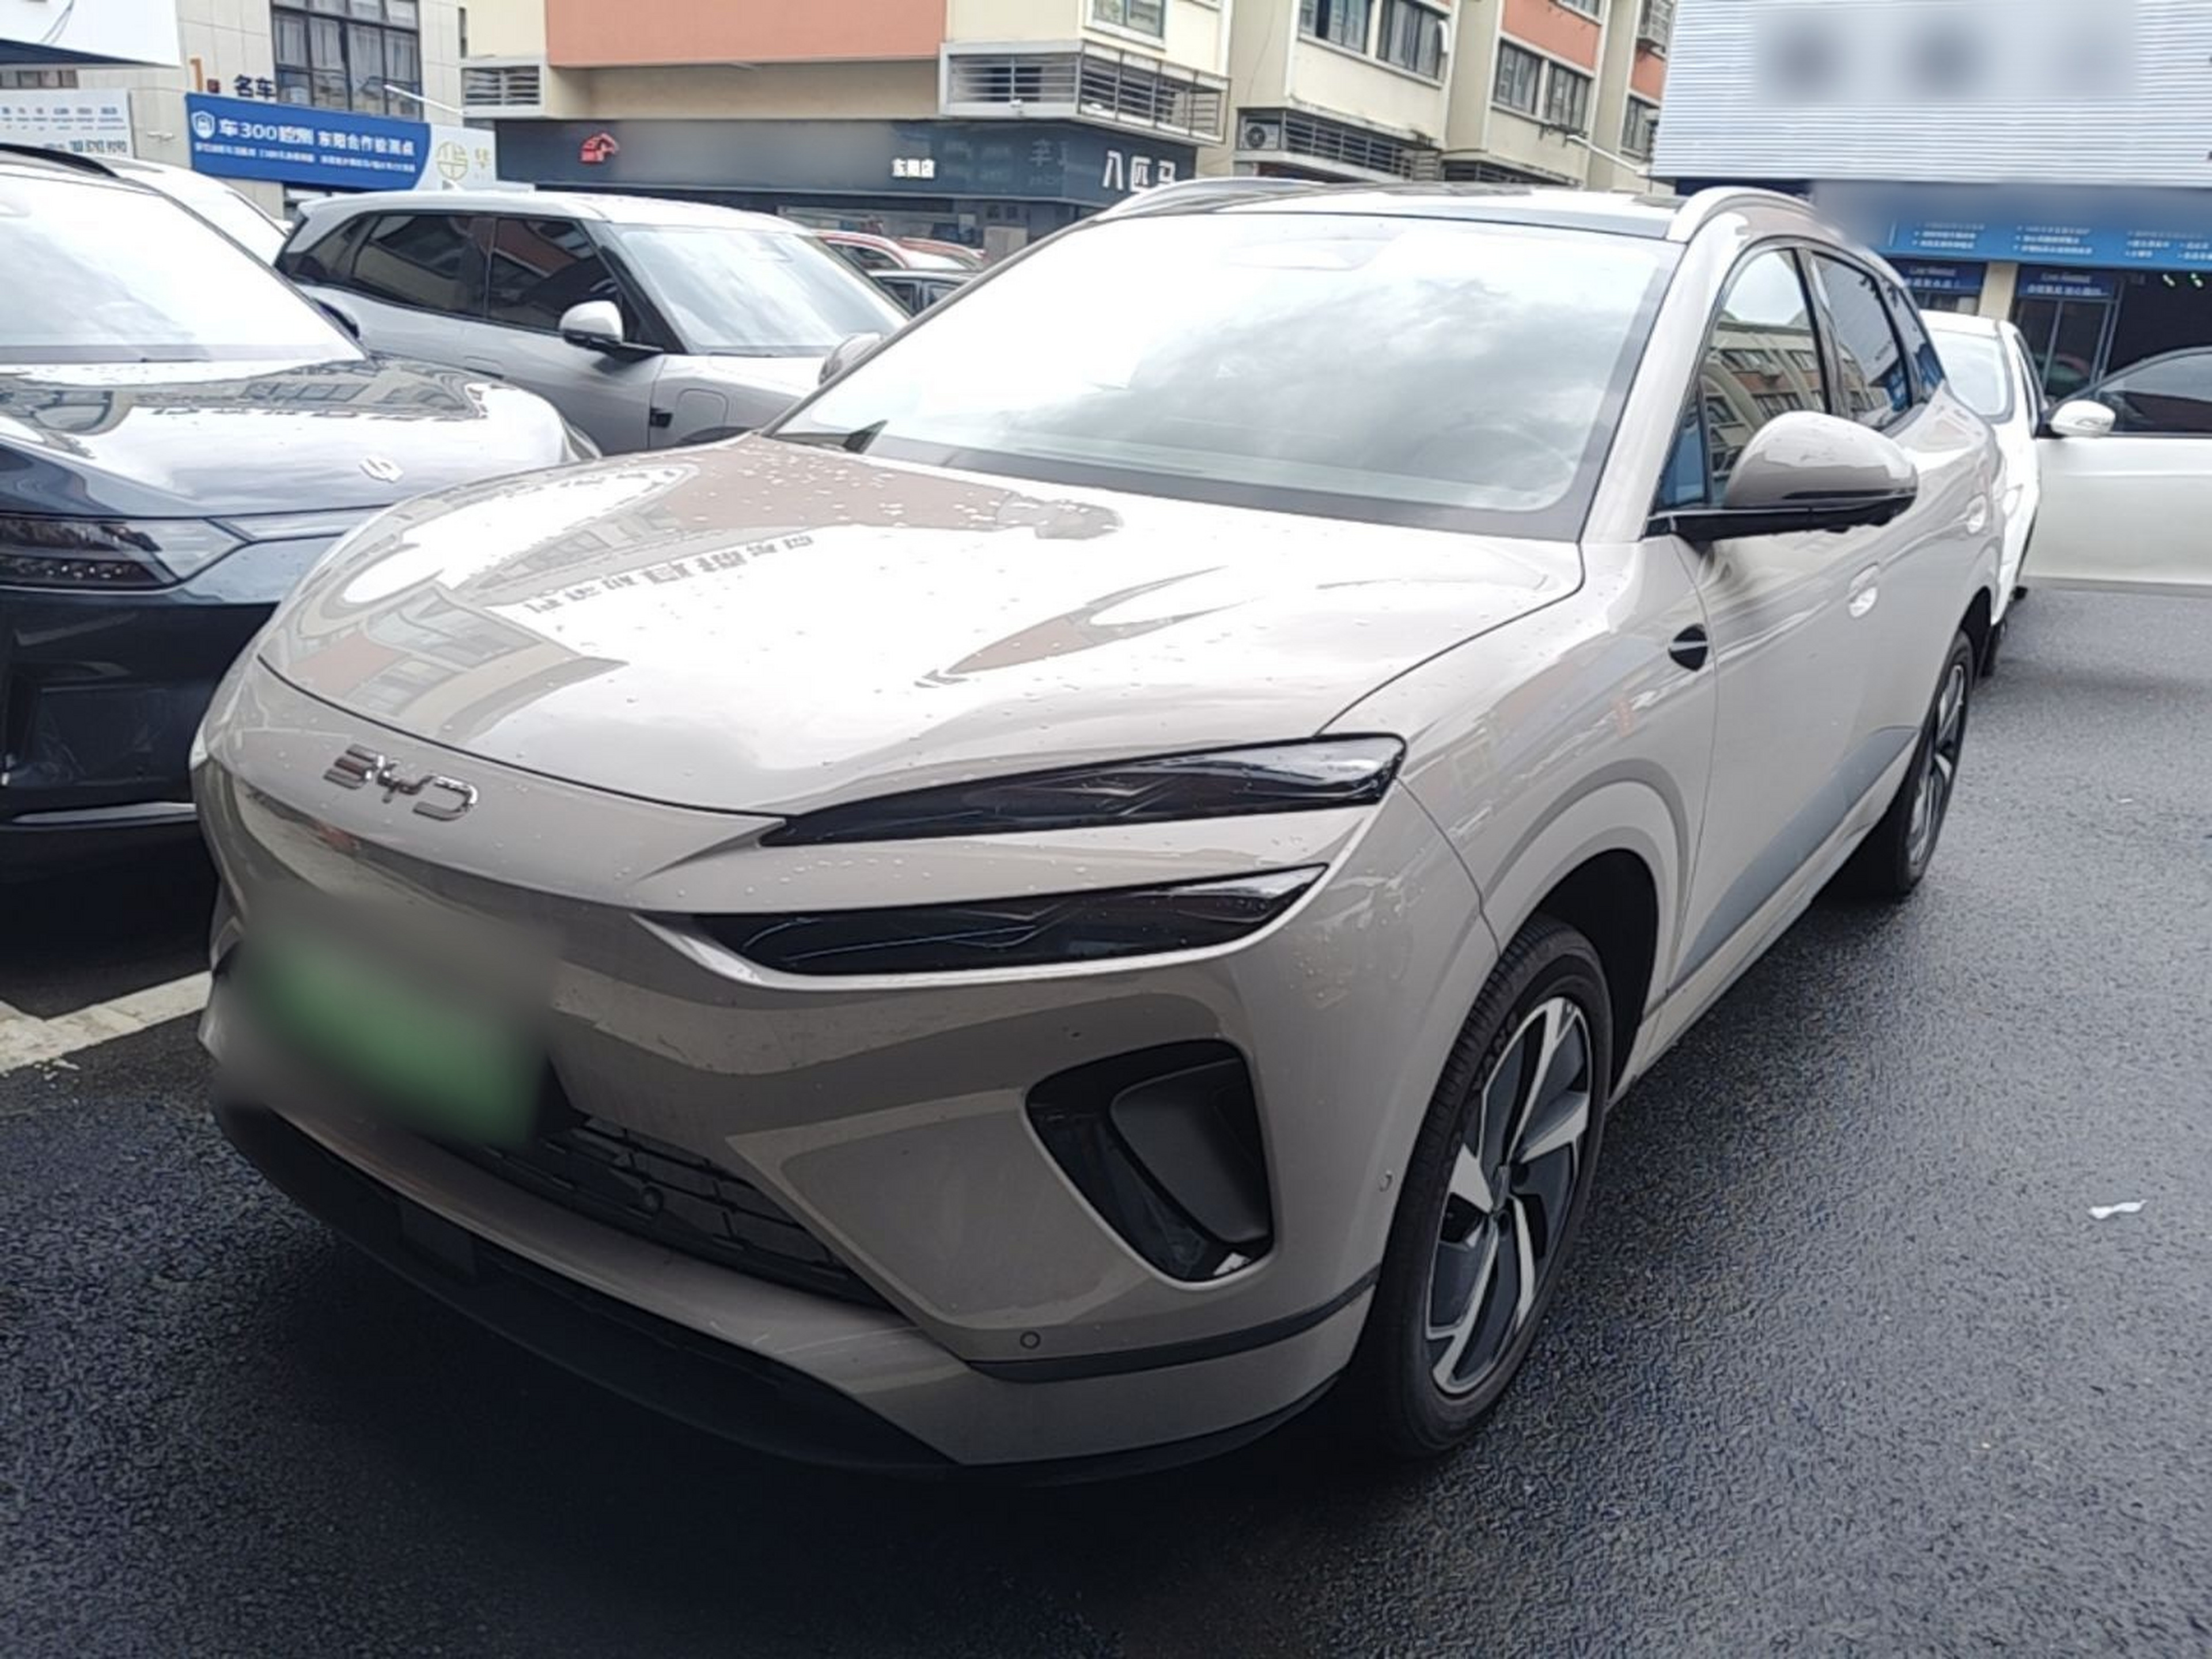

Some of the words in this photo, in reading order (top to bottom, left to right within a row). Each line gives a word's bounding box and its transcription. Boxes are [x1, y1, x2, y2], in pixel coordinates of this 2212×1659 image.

[233, 74, 276, 100] 名车
[1101, 150, 1177, 194] 八匹马
[323, 744, 479, 821] BYD
